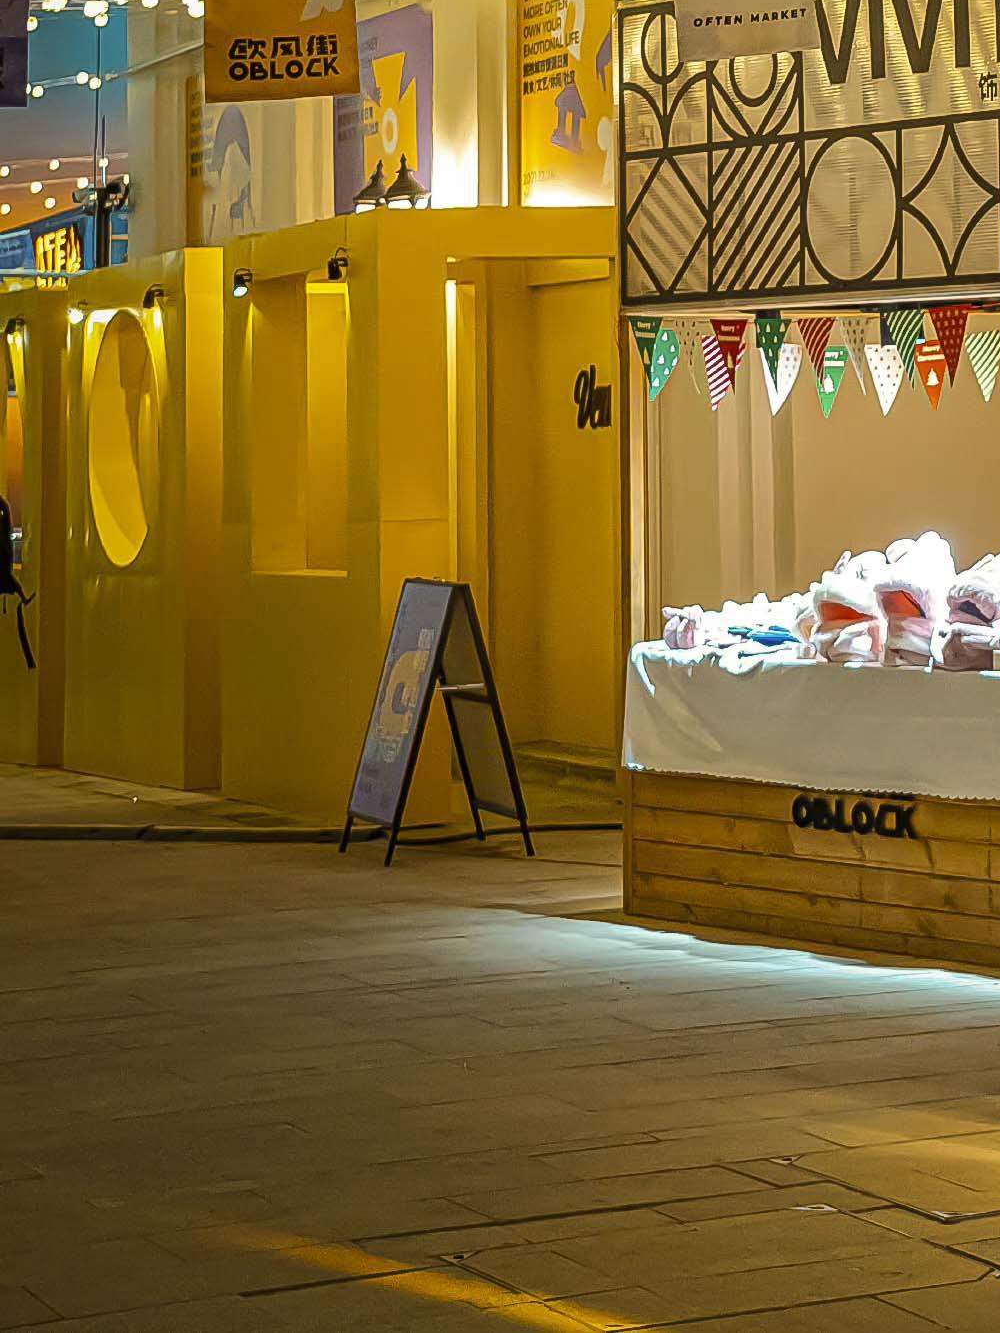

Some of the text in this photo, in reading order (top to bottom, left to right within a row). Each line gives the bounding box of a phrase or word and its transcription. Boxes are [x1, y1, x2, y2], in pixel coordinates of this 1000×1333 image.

[693, 8, 807, 28] OFTEN MARKET
[229, 34, 338, 59] 欧风街
[228, 57, 340, 81] OBLOCK
[791, 793, 919, 840] OBLOCK
